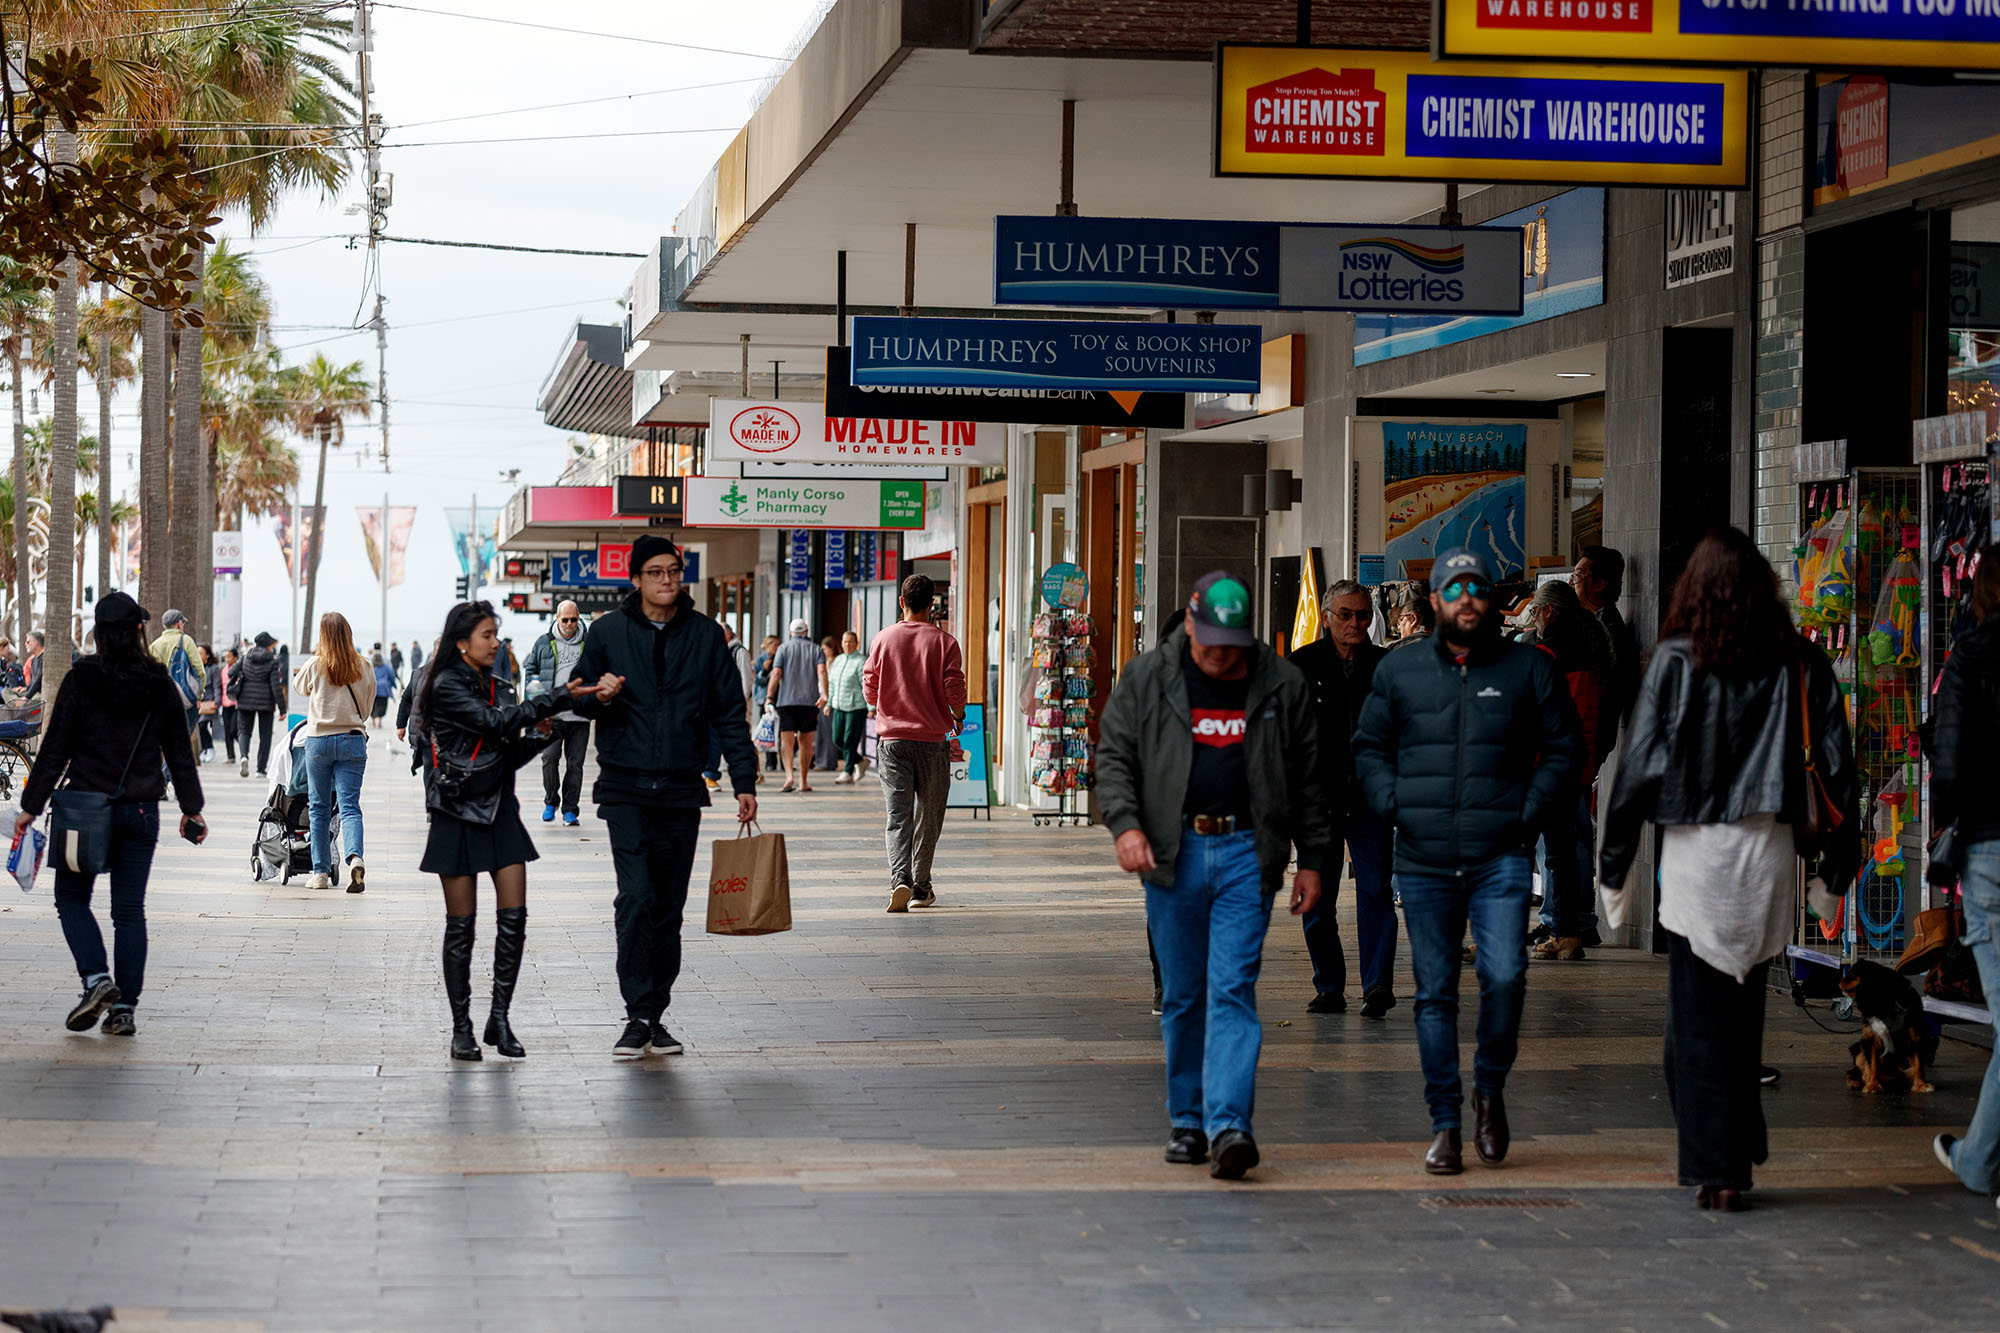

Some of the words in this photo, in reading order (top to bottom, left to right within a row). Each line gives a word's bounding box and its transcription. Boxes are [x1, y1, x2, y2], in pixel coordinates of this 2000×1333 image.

[1487, 0, 1640, 20] WAREHOUSE
[1275, 87, 1292, 95] Stop
[1293, 87, 1318, 96] Paying
[1334, 88, 1360, 96] Much!!
[1254, 97, 1379, 128] CHEMIST
[1422, 96, 1535, 140] CHEMIST
[1546, 100, 1705, 145] WAREHOUSE
[1839, 97, 1887, 150] CHEMIST
[1254, 129, 1374, 146] WAREHOUSE
[1840, 144, 1884, 175] WAREHOUSE
[1014, 241, 1260, 277] HUMPHREYS
[1342, 253, 1393, 270] NSW
[1338, 272, 1464, 302] Lotteries
[867, 336, 1057, 364] HUMPHREYS
[1070, 334, 1110, 350] TOY
[1115, 335, 1128, 351] &
[1136, 336, 1192, 352] BOOK
[1199, 337, 1251, 353] SHOP
[1104, 357, 1216, 374] SOUVENIRS
[741, 429, 774, 441] MADE
[777, 430, 789, 441] IN
[824, 417, 930, 445] MADE
[941, 420, 976, 447] IN
[1407, 430, 1454, 443] MANLY
[1460, 431, 1504, 443] BEACH
[838, 445, 963, 456] HOMEWARES
[756, 487, 800, 501] Manly
[803, 488, 845, 500] Corso
[756, 501, 827, 516] Pharmacy
[713, 873, 749, 895] coles
